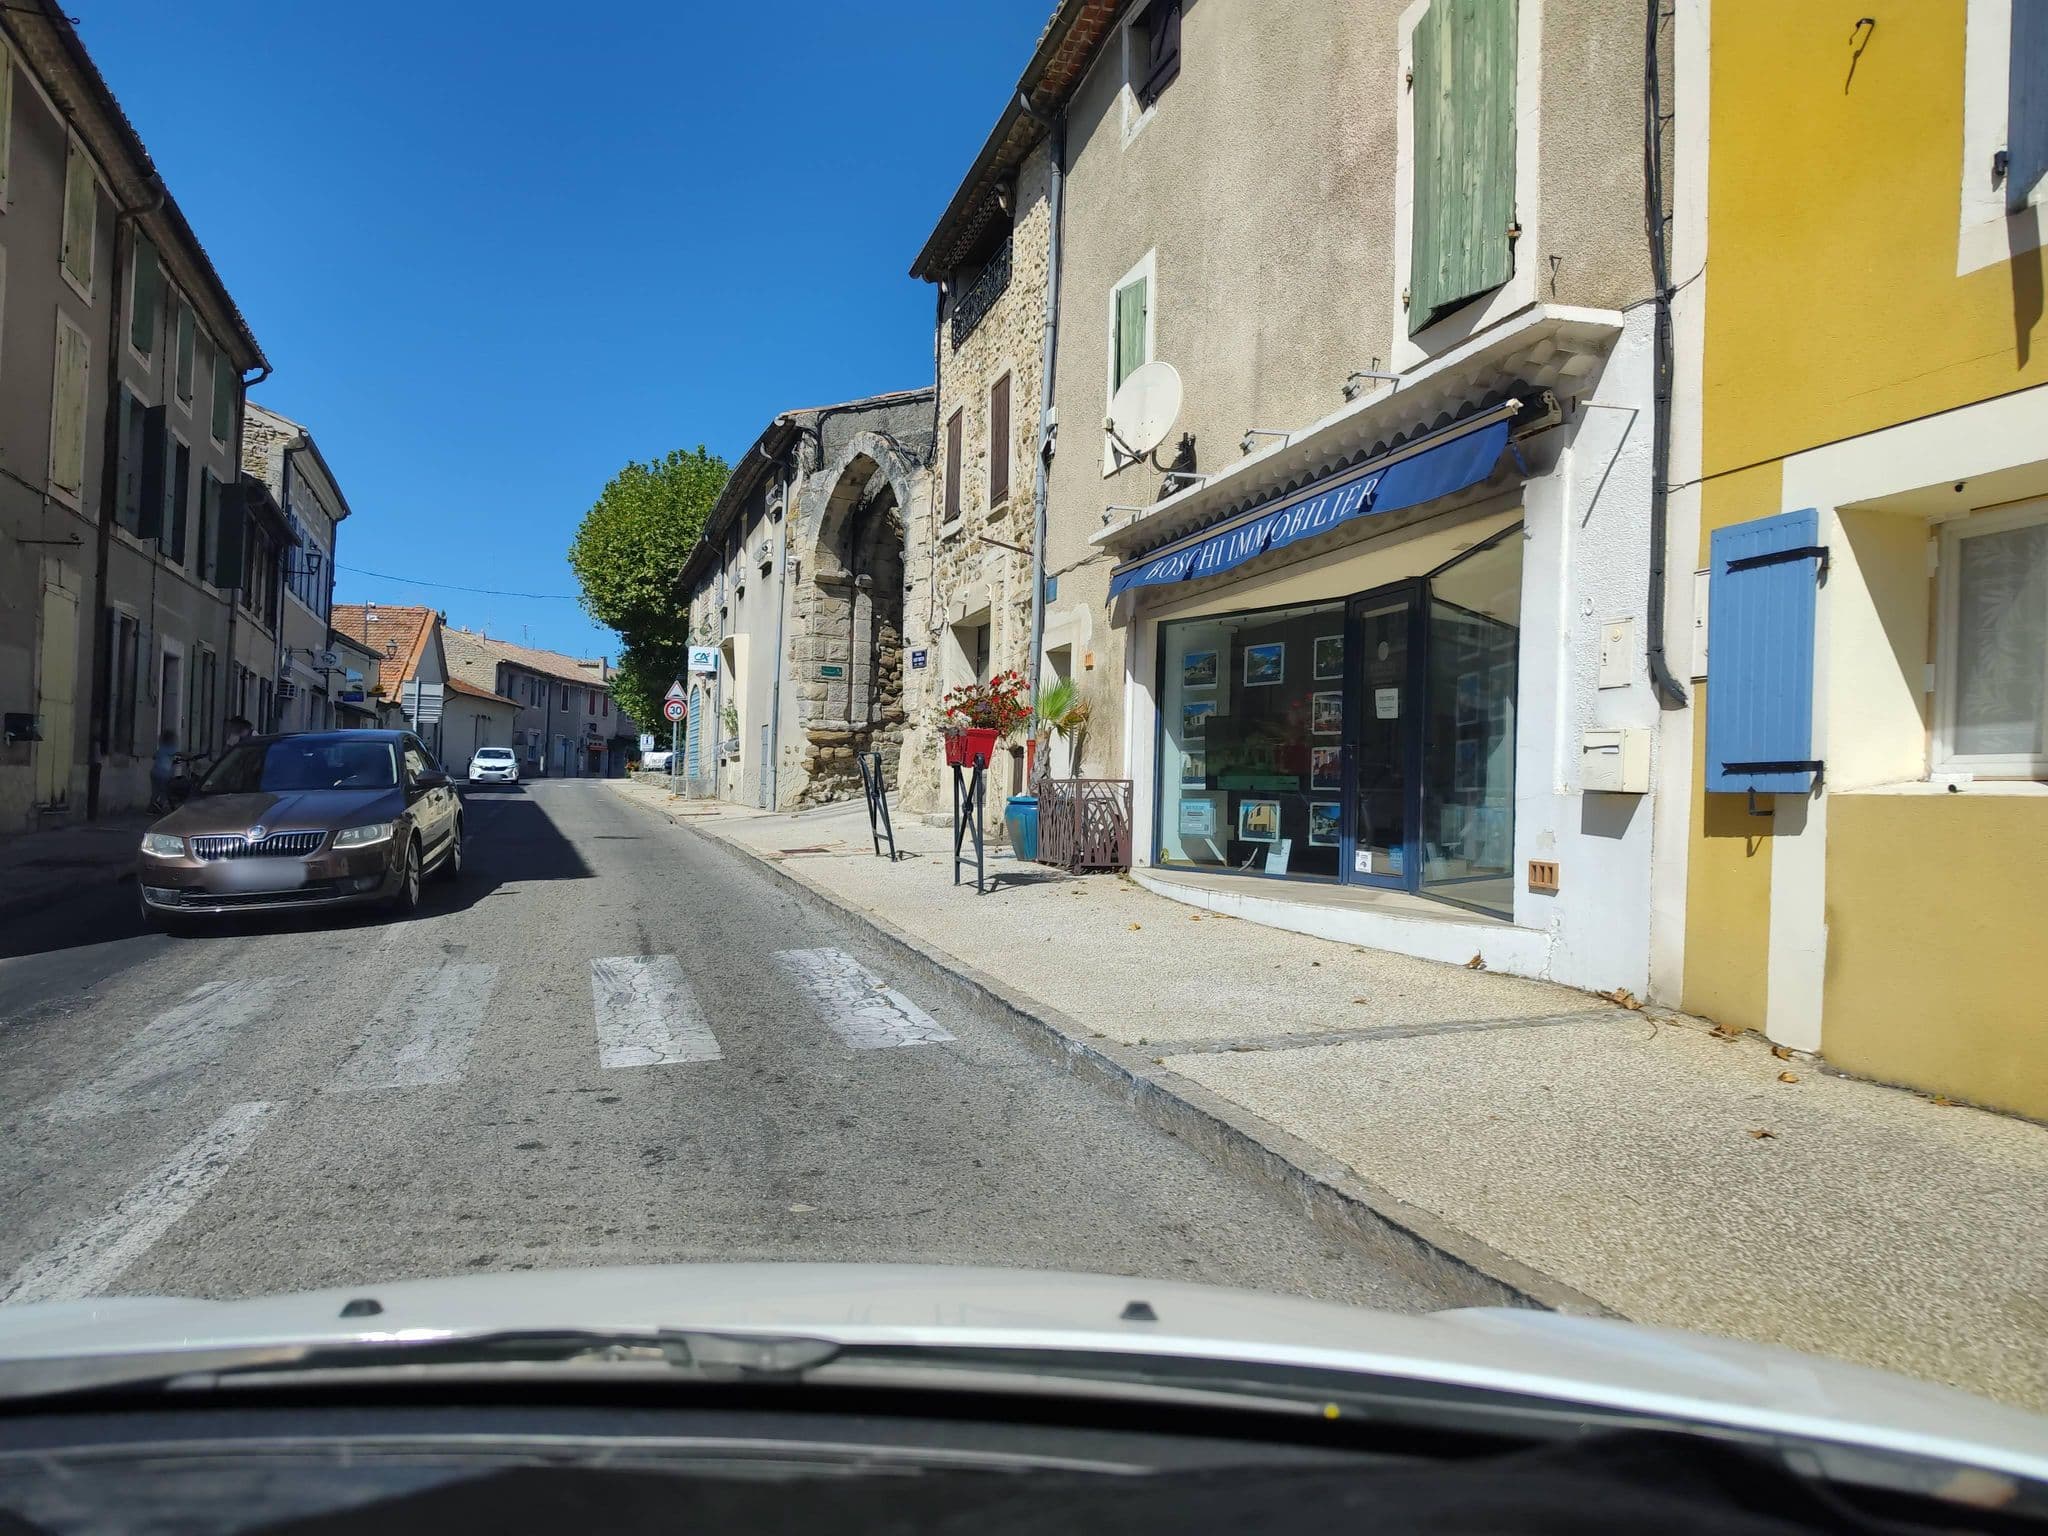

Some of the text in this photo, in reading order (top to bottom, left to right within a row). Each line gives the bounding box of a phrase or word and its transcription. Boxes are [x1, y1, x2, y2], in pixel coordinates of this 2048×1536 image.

[1145, 477, 1380, 580] BOSCHI IMMOBILIER
[669, 706, 682, 715] 30
